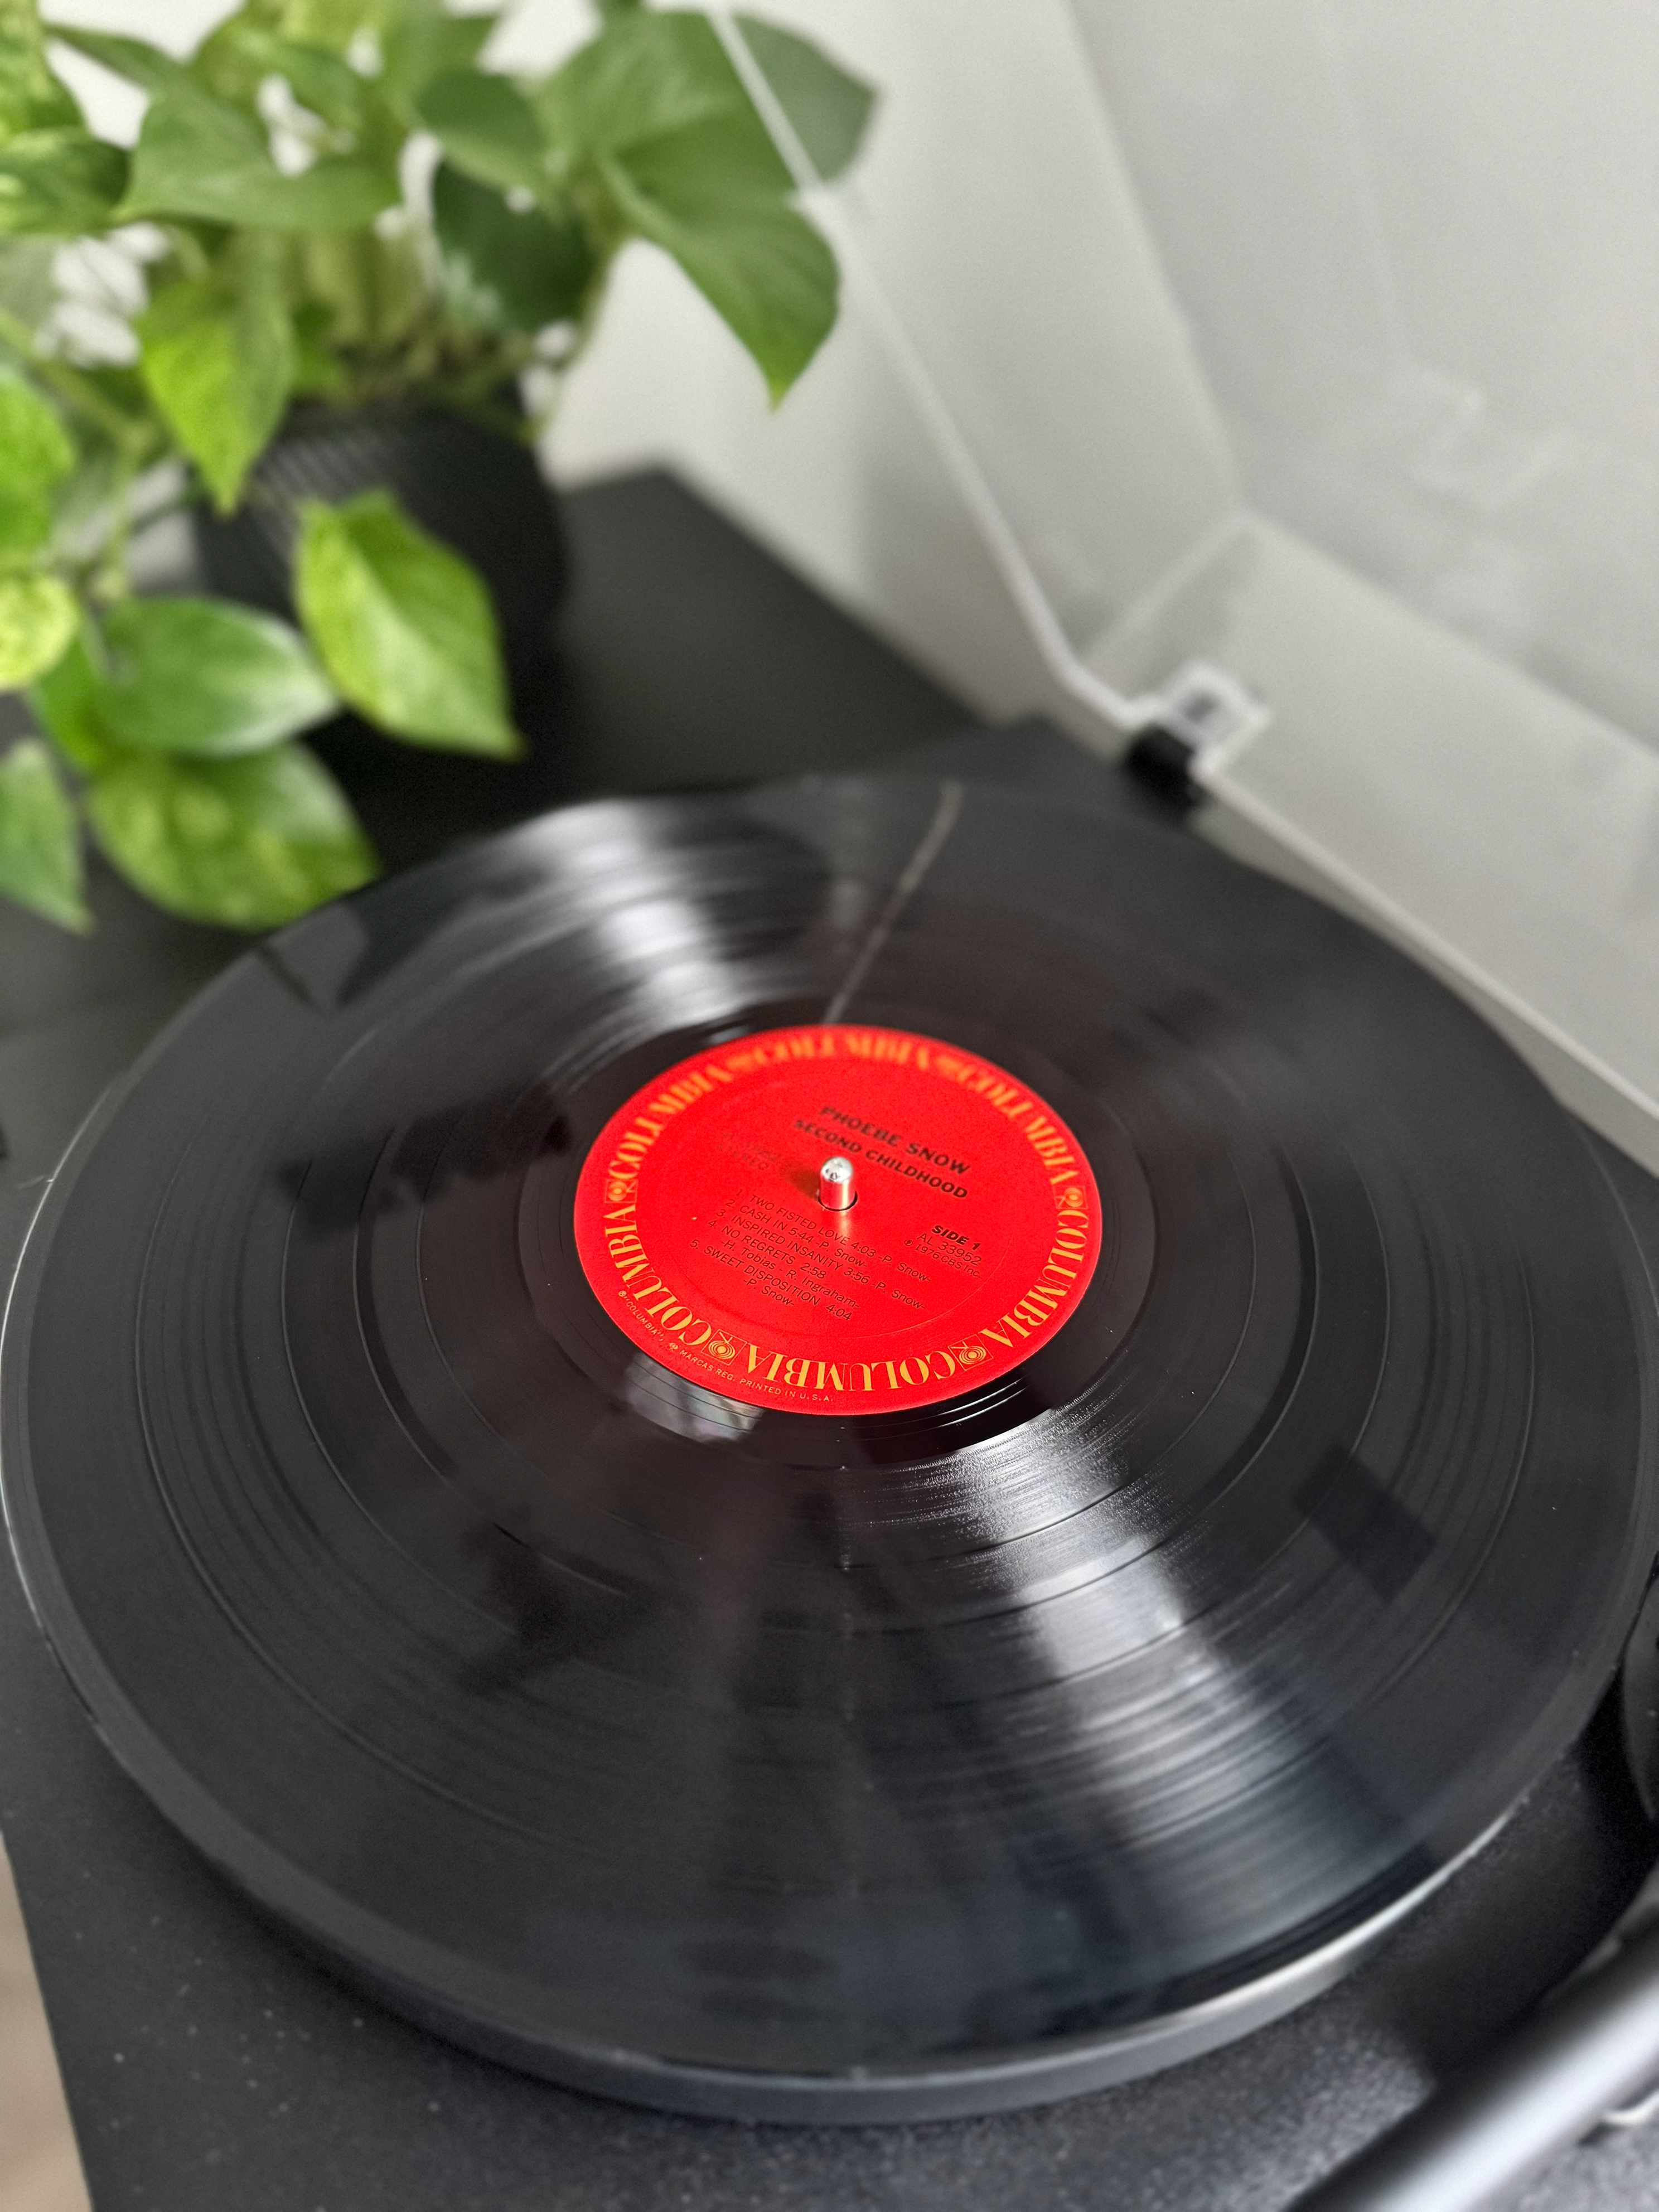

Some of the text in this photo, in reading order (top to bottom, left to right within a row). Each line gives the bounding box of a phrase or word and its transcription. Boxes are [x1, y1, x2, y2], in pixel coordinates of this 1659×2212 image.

[608, 1064, 733, 1179] COLUMBIA
[819, 1105, 970, 1175] PHOEBE SNOW
[794, 1118, 862, 1153] SECOND
[865, 1149, 968, 1198] CHILDHOOD
[721, 1226, 740, 1238] NO
[742, 1235, 796, 1265] REGRETS
[800, 1263, 826, 1279] 2:58
[731, 1215, 785, 1245] INSPIRED
[787, 1241, 844, 1270] INSANITY
[844, 1267, 870, 1284] 3:56
[739, 1205, 771, 1224] CASH
[773, 1220, 788, 1231] IN
[789, 1227, 814, 1243] 5:44
[749, 1195, 775, 1211] TWO
[776, 1207, 816, 1230] FISTED
[818, 1227, 850, 1246] LOVE
[851, 1242, 876, 1257] 4:03
[917, 1233, 981, 1266] AL 33952
[931, 1225, 969, 1245] SIDE
[603, 1203, 711, 1345] COLUMBIA
[690, 1239, 852, 1320] 5. SWEET DISPOSITION 4:04
[741, 1247, 776, 1270] Tobias
[786, 1270, 796, 1280] R.
[915, 1244, 940, 1259] 1976
[941, 1255, 962, 1269] CBS
[964, 1265, 980, 1278] Inc.
[978, 1209, 1089, 1347] COLUMBIA
[680, 1350, 714, 1371] MARCAS
[715, 1368, 735, 1382] REG.
[739, 1378, 781, 1395] PRINTED
[746, 1343, 955, 1391] COLUMBIA
